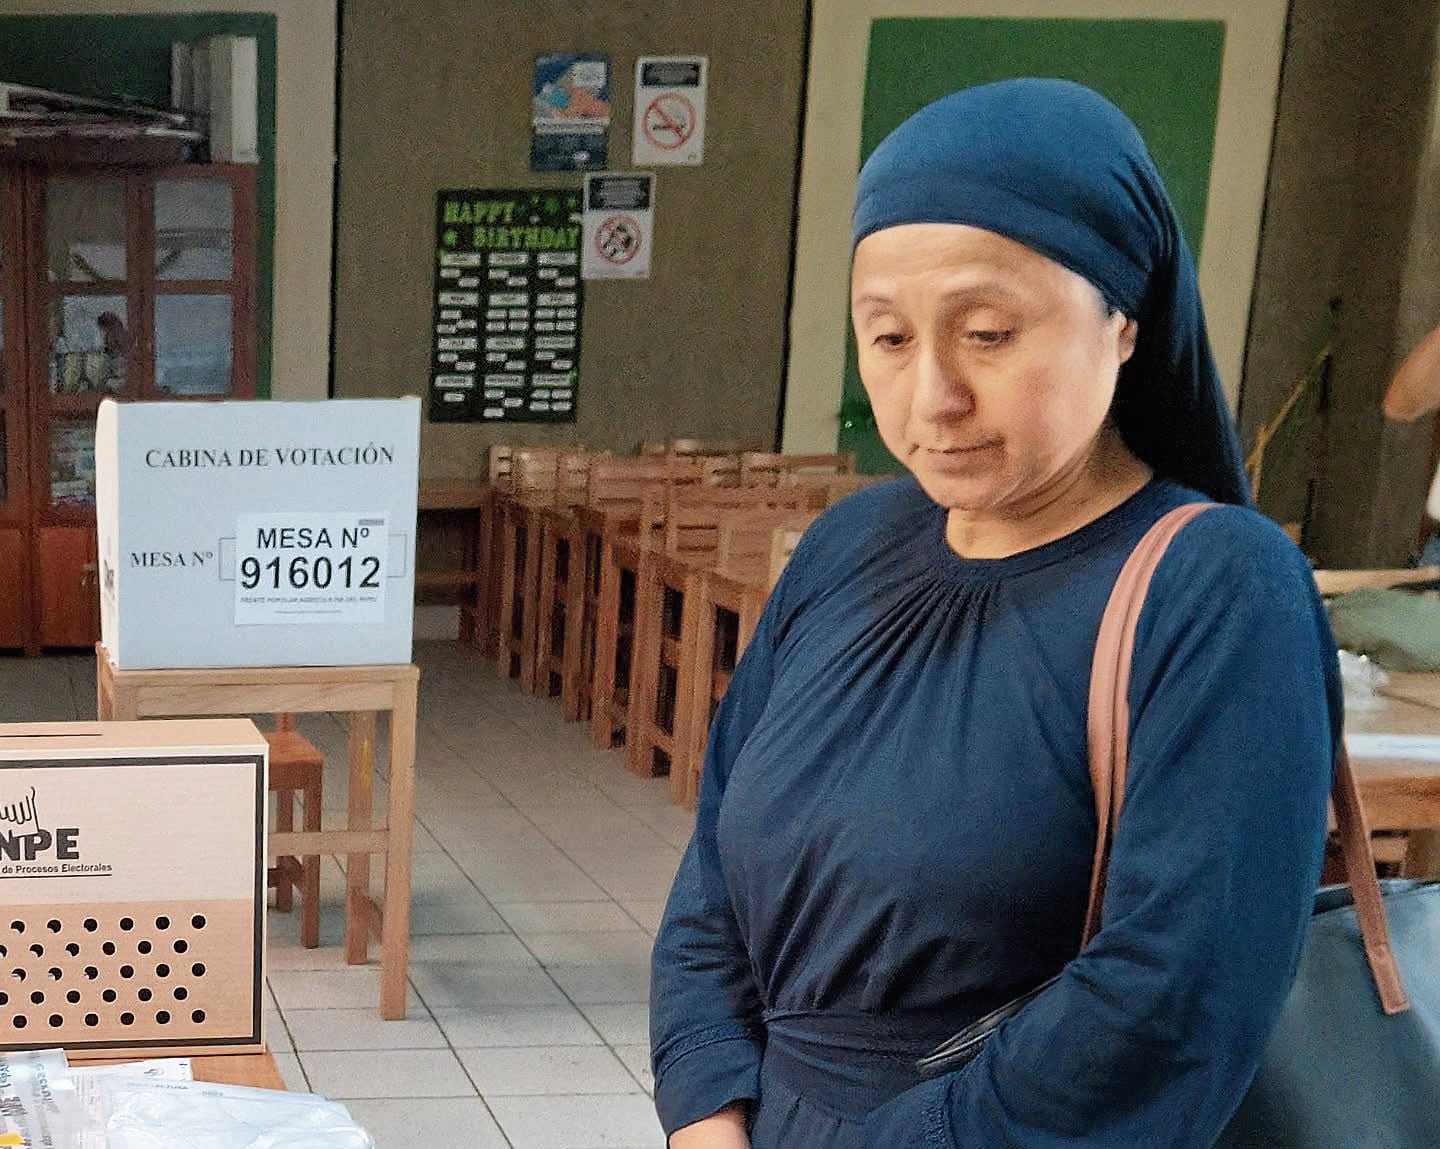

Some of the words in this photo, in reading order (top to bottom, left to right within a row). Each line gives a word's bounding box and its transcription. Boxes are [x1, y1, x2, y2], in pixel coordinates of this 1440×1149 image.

[443, 201, 514, 223] HAPPY
[472, 226, 580, 249] BIRTHDAY
[145, 448, 232, 468] CABINA
[239, 448, 270, 467] DE
[275, 441, 394, 466] VOTACIÓN
[257, 527, 332, 549] MESA
[130, 552, 186, 568] MESA
[241, 556, 380, 589] 916012
[2, 864, 14, 873] de
[16, 864, 58, 873] Procesos
[61, 862, 112, 872] Electorales
